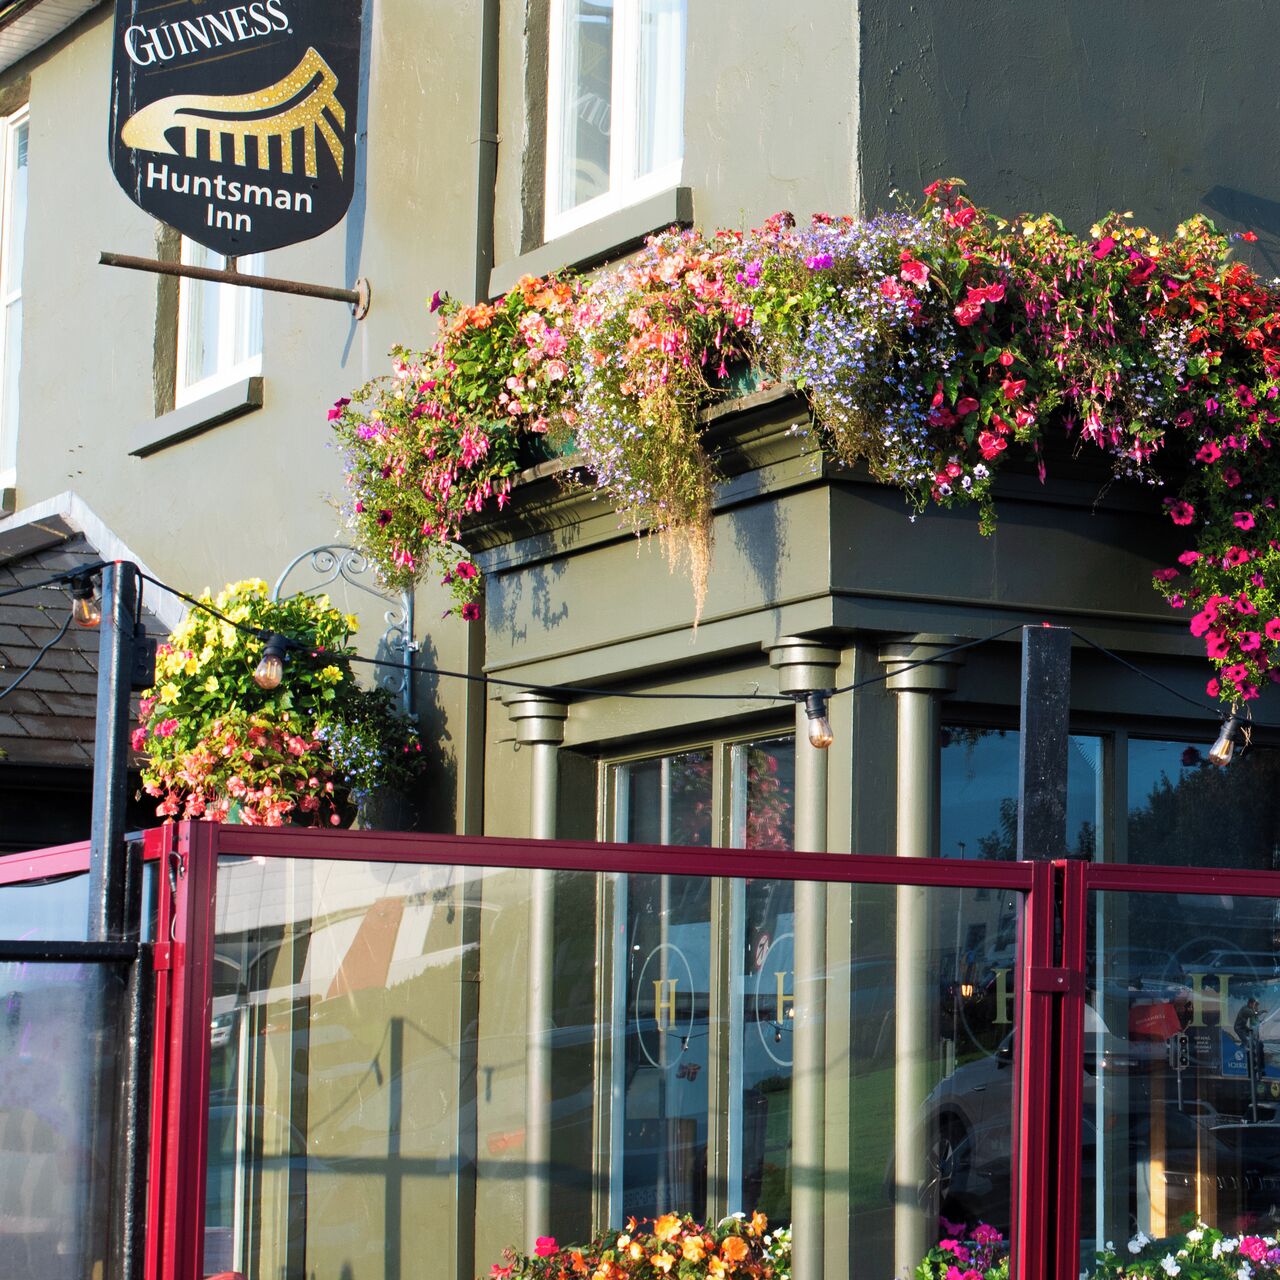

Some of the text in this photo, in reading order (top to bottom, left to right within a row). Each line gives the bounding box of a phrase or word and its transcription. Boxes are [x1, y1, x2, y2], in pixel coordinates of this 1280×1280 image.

[147, 163, 313, 214] Huntsman
[207, 204, 252, 233] Inn
[652, 978, 678, 1031] H
[1191, 973, 1230, 1028] H
